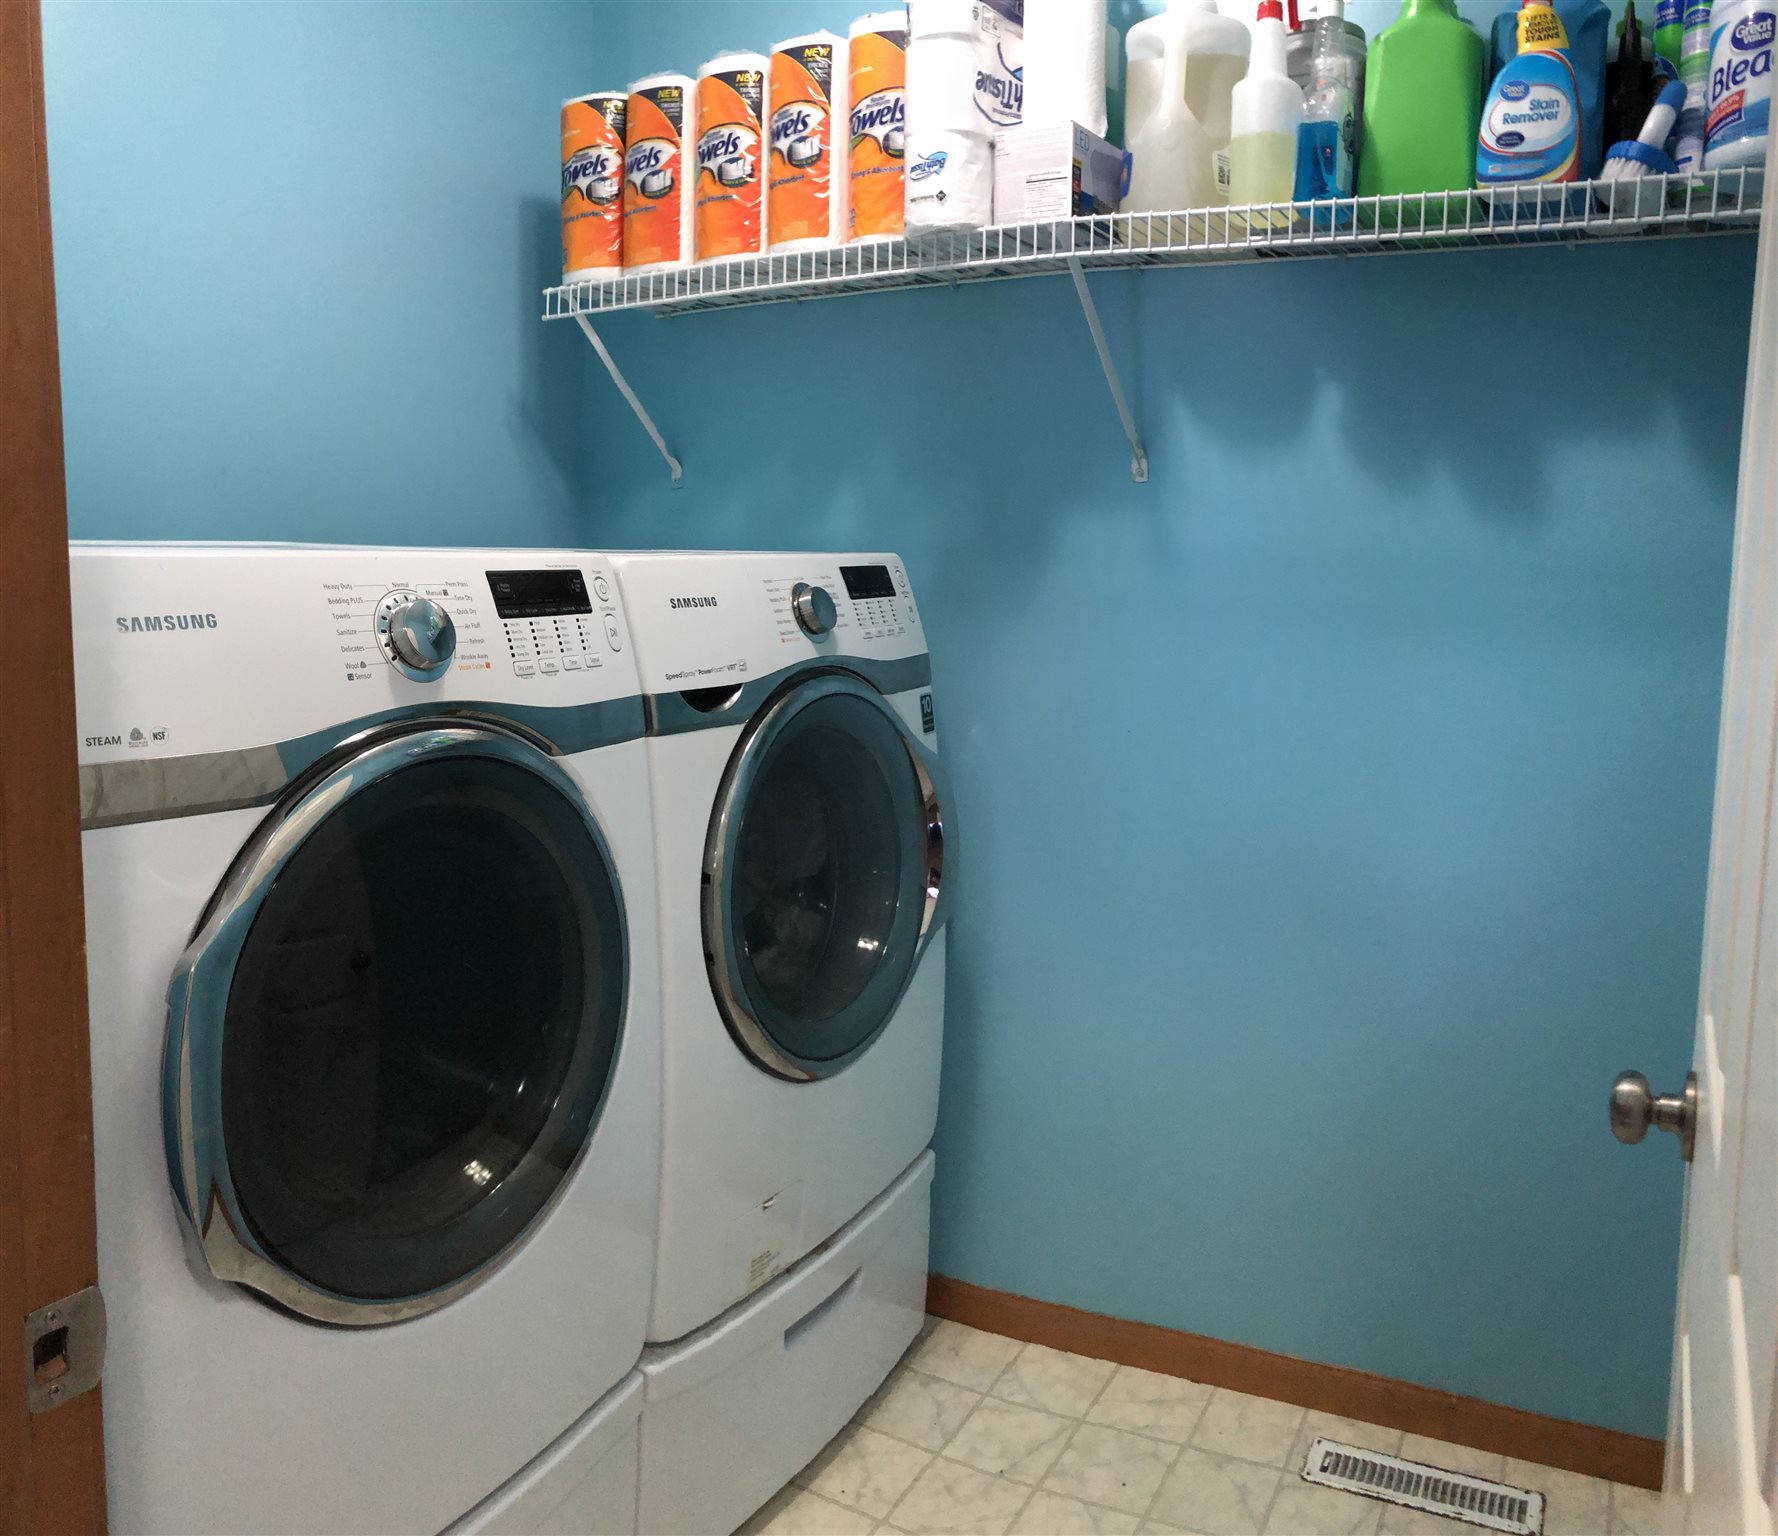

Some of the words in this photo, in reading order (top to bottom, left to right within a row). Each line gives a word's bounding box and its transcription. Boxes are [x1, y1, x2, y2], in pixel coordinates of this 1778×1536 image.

[1736, 18, 1773, 39] Great
[1525, 32, 1561, 43] STAINS
[1743, 31, 1772, 44] Value
[804, 47, 831, 58] NEW
[1712, 49, 1775, 104] Blea
[657, 88, 682, 98] NEW
[1529, 97, 1560, 111] Stain
[1502, 110, 1560, 125] Remover
[772, 110, 811, 142] wels
[698, 133, 741, 164] wels
[323, 583, 341, 592] Heavy
[341, 583, 354, 592] Duty
[327, 598, 351, 606] Bedding
[464, 594, 473, 603] Dry
[670, 596, 718, 609] SAMSUNG
[331, 612, 352, 620] Towels
[456, 608, 469, 616] Quick
[116, 613, 218, 633] SAMSUNG
[336, 628, 358, 637] Sanitize
[340, 644, 366, 654] Delicates
[344, 661, 360, 669] Wool
[354, 672, 373, 681] Sensor
[85, 735, 122, 747] STEAM
[152, 731, 166, 741] NSF
